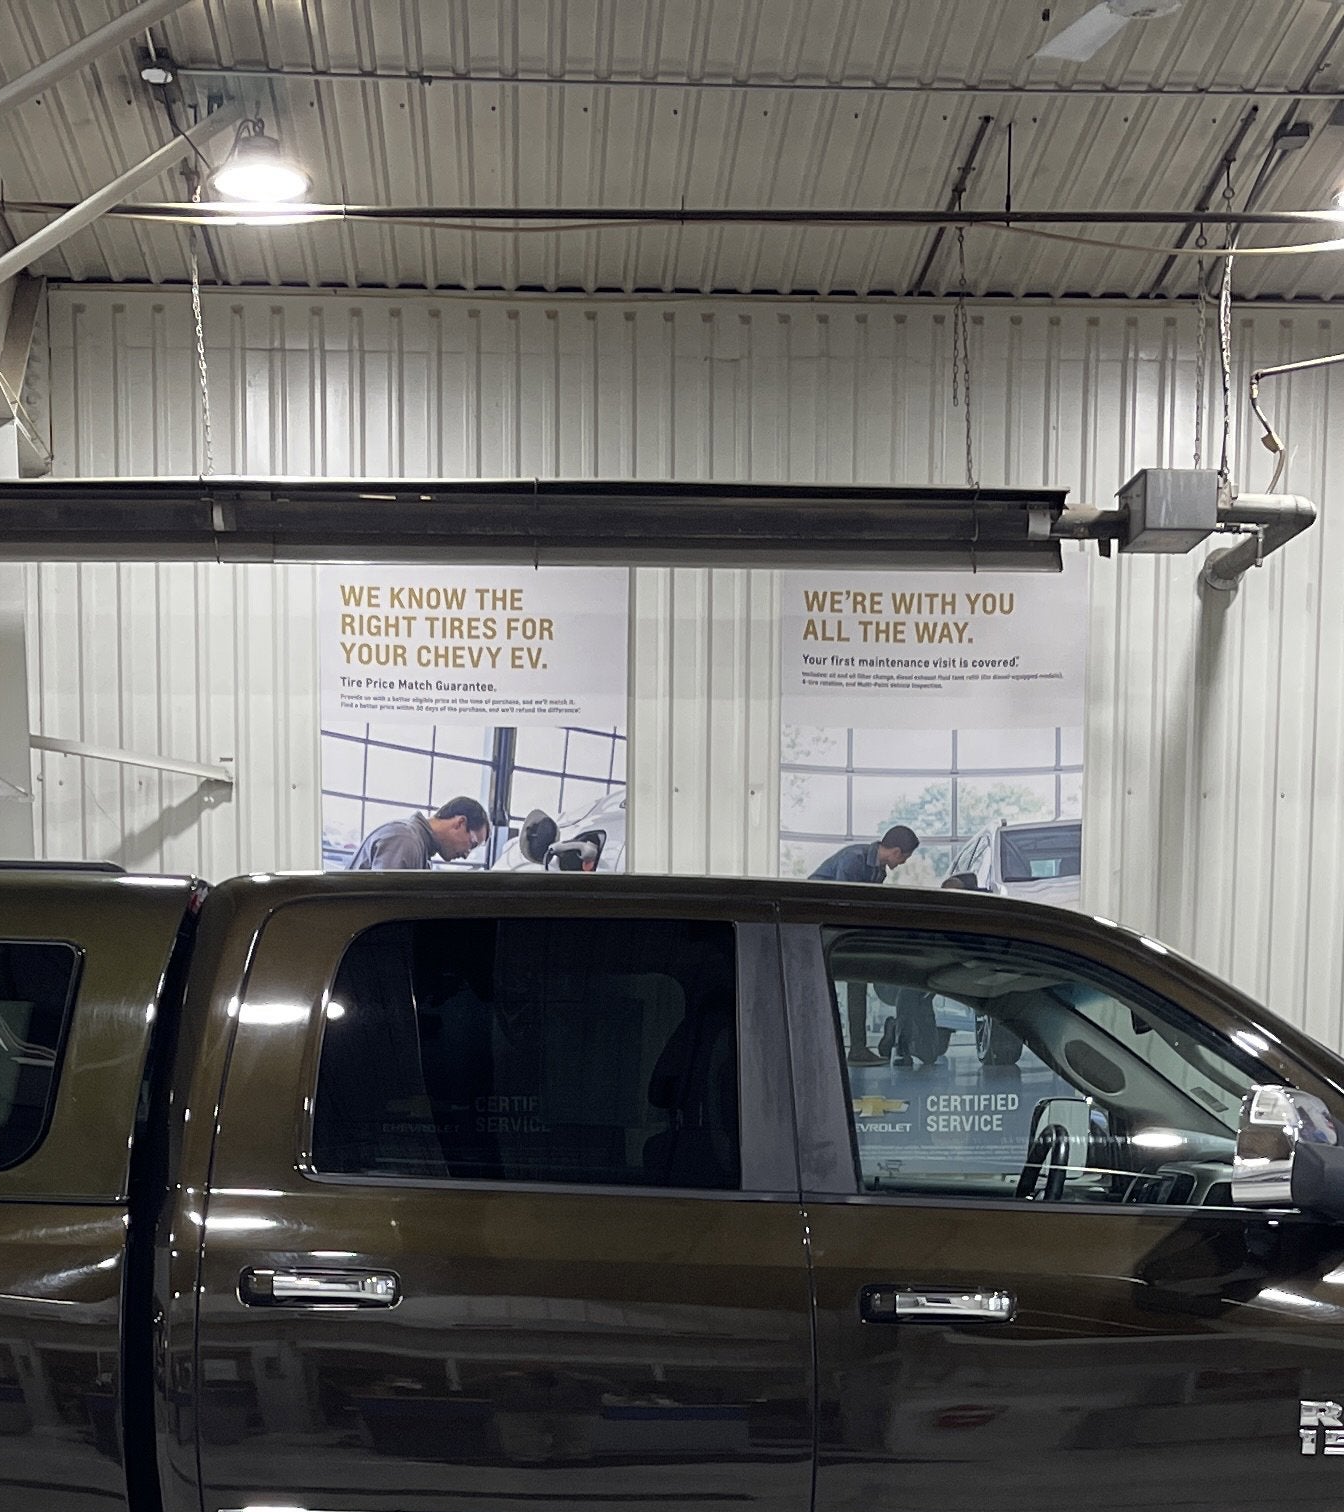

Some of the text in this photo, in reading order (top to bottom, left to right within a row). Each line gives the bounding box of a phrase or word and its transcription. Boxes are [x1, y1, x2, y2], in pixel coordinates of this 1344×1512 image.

[340, 585, 523, 610] WE KNOW THE
[804, 590, 1014, 615] WE'RE WITH YOU
[341, 614, 553, 640] RIGHT TIRES FOR
[802, 619, 973, 644] ALL THE WAY.
[340, 642, 547, 669] YOUR CHEVY EV.
[802, 654, 827, 665] Your
[831, 656, 855, 667] first
[858, 657, 929, 668] maintenance
[932, 657, 956, 668] visit
[959, 658, 968, 668] is
[340, 677, 496, 692] Tire Price Match Guarantee.
[926, 1094, 1018, 1112] CERTIFIED
[926, 1115, 1003, 1132] SERVICE
